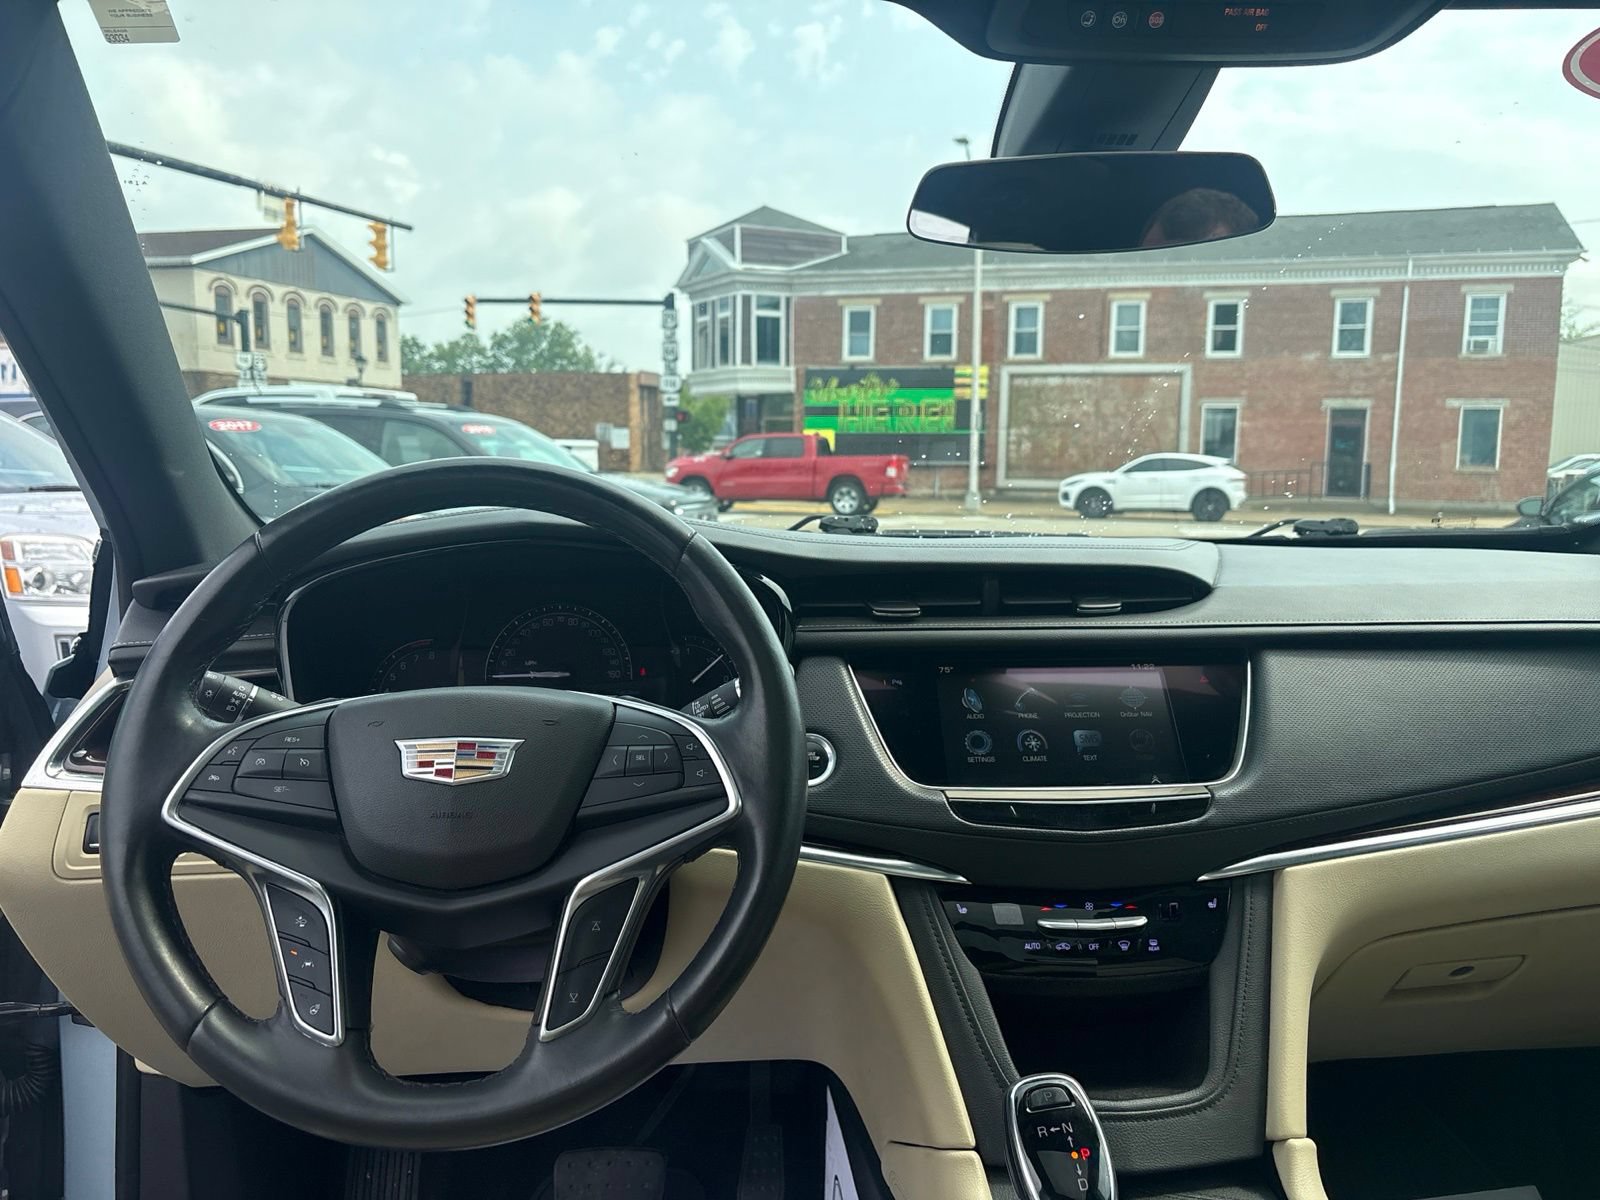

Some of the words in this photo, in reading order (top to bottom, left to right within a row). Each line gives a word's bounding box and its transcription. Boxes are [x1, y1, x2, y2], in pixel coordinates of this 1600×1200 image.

[1224, 8, 1242, 16] PASS
[1243, 8, 1255, 16] AIR
[1255, 8, 1270, 16] BAG
[1255, 23, 1269, 31] OFF
[232, 690, 247, 699] AUTO
[1078, 734, 1099, 744] SMS
[1024, 942, 1041, 950] AUTO
[1088, 942, 1100, 950] OFF
[1043, 1091, 1052, 1101] P
[1036, 1125, 1048, 1138] R
[1061, 1121, 1074, 1134] N
[1080, 1147, 1091, 1161] P
[1077, 1177, 1089, 1192] D
